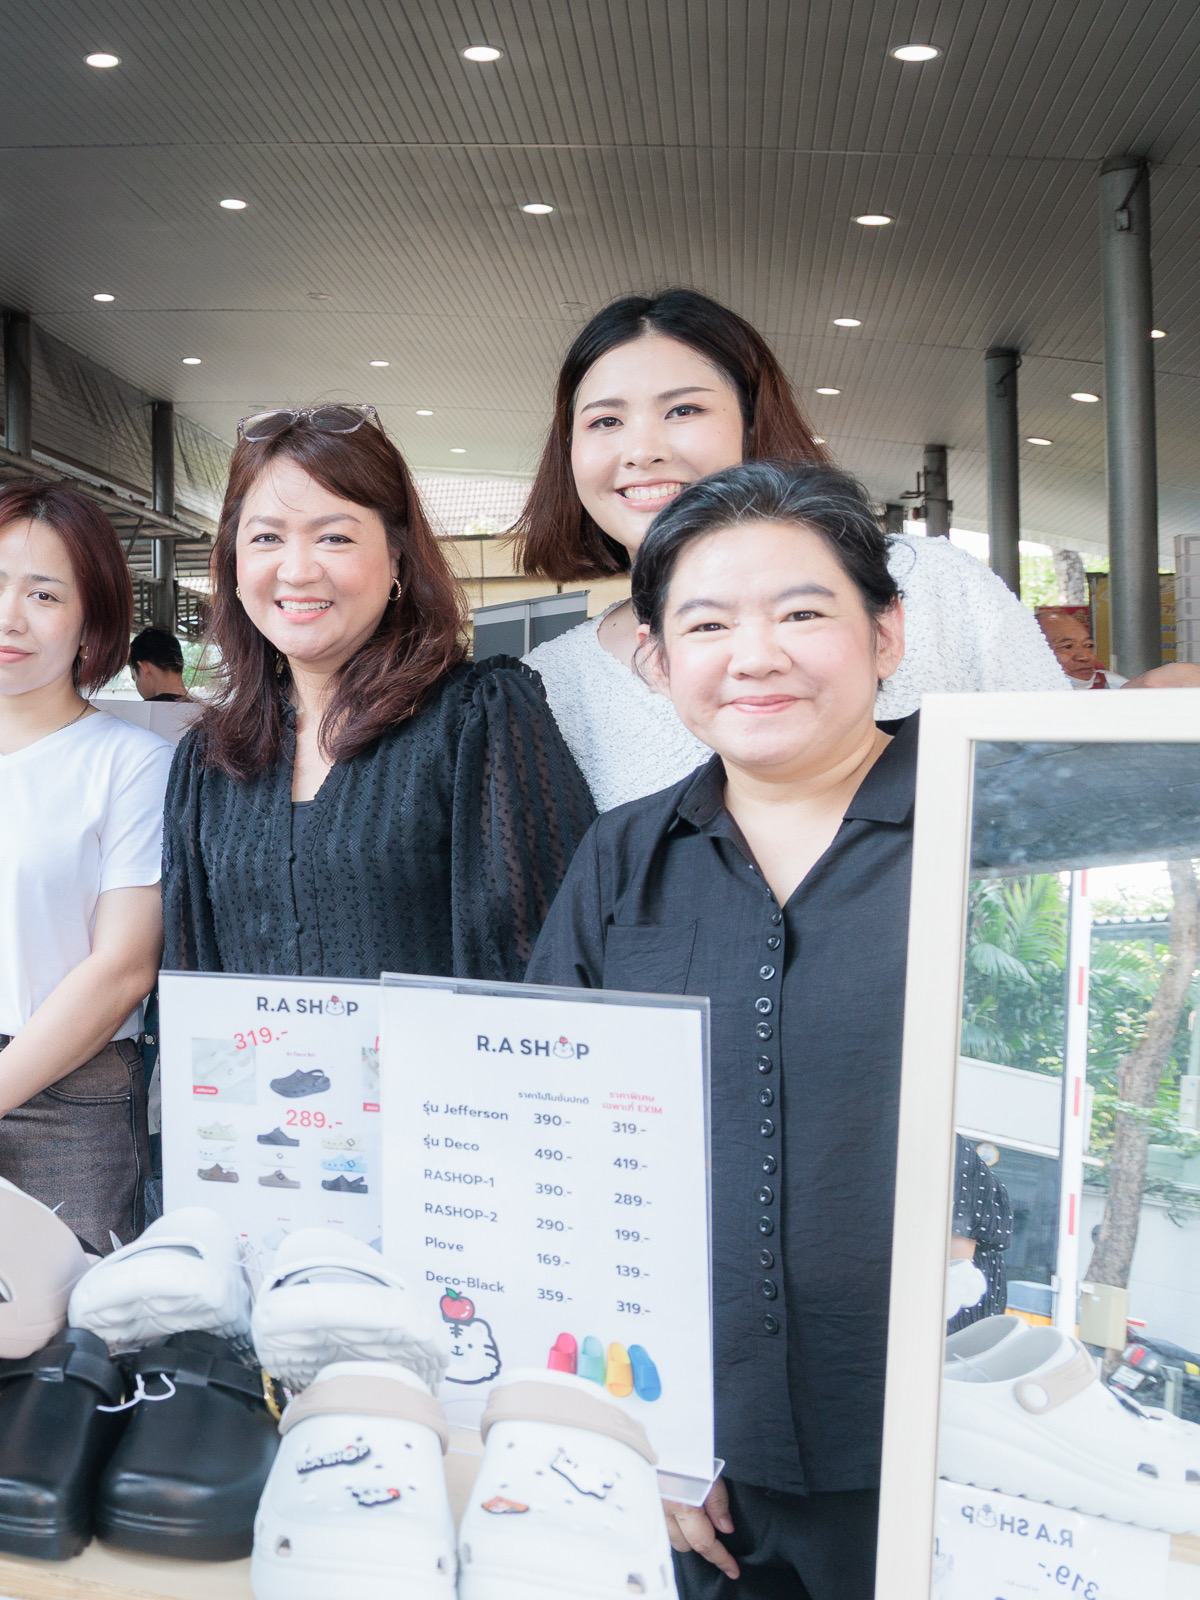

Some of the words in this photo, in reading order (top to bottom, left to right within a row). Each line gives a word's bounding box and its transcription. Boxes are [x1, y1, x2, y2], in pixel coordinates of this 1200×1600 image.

[256, 996, 290, 1013] R.A
[233, 1026, 288, 1051] 319.-
[476, 1035, 514, 1055] R.A
[423, 1100, 439, 1116] รุ่น
[443, 1103, 509, 1121] Jefferson
[637, 1105, 663, 1115] EXIM
[286, 1109, 343, 1128] 289.-
[533, 1113, 571, 1127] 390.-
[612, 1121, 647, 1135] 319.-
[423, 1134, 439, 1150] รุ่น
[444, 1138, 480, 1152] Deco
[534, 1148, 573, 1162] 490.-
[613, 1157, 648, 1171] 419.-
[424, 1168, 495, 1188] RASHOP-1
[535, 1183, 573, 1197] 390.-
[614, 1192, 653, 1207] 289.-
[424, 1203, 498, 1223] RASHOP-2
[536, 1218, 574, 1232] 290.-
[615, 1228, 651, 1243] 199.-
[425, 1236, 464, 1252] Plove
[536, 1253, 570, 1268] 169.-
[615, 1264, 650, 1279] 139.-
[425, 1270, 505, 1293] Deco-Black
[537, 1288, 573, 1303] 359.-
[616, 1300, 651, 1315] 319.-
